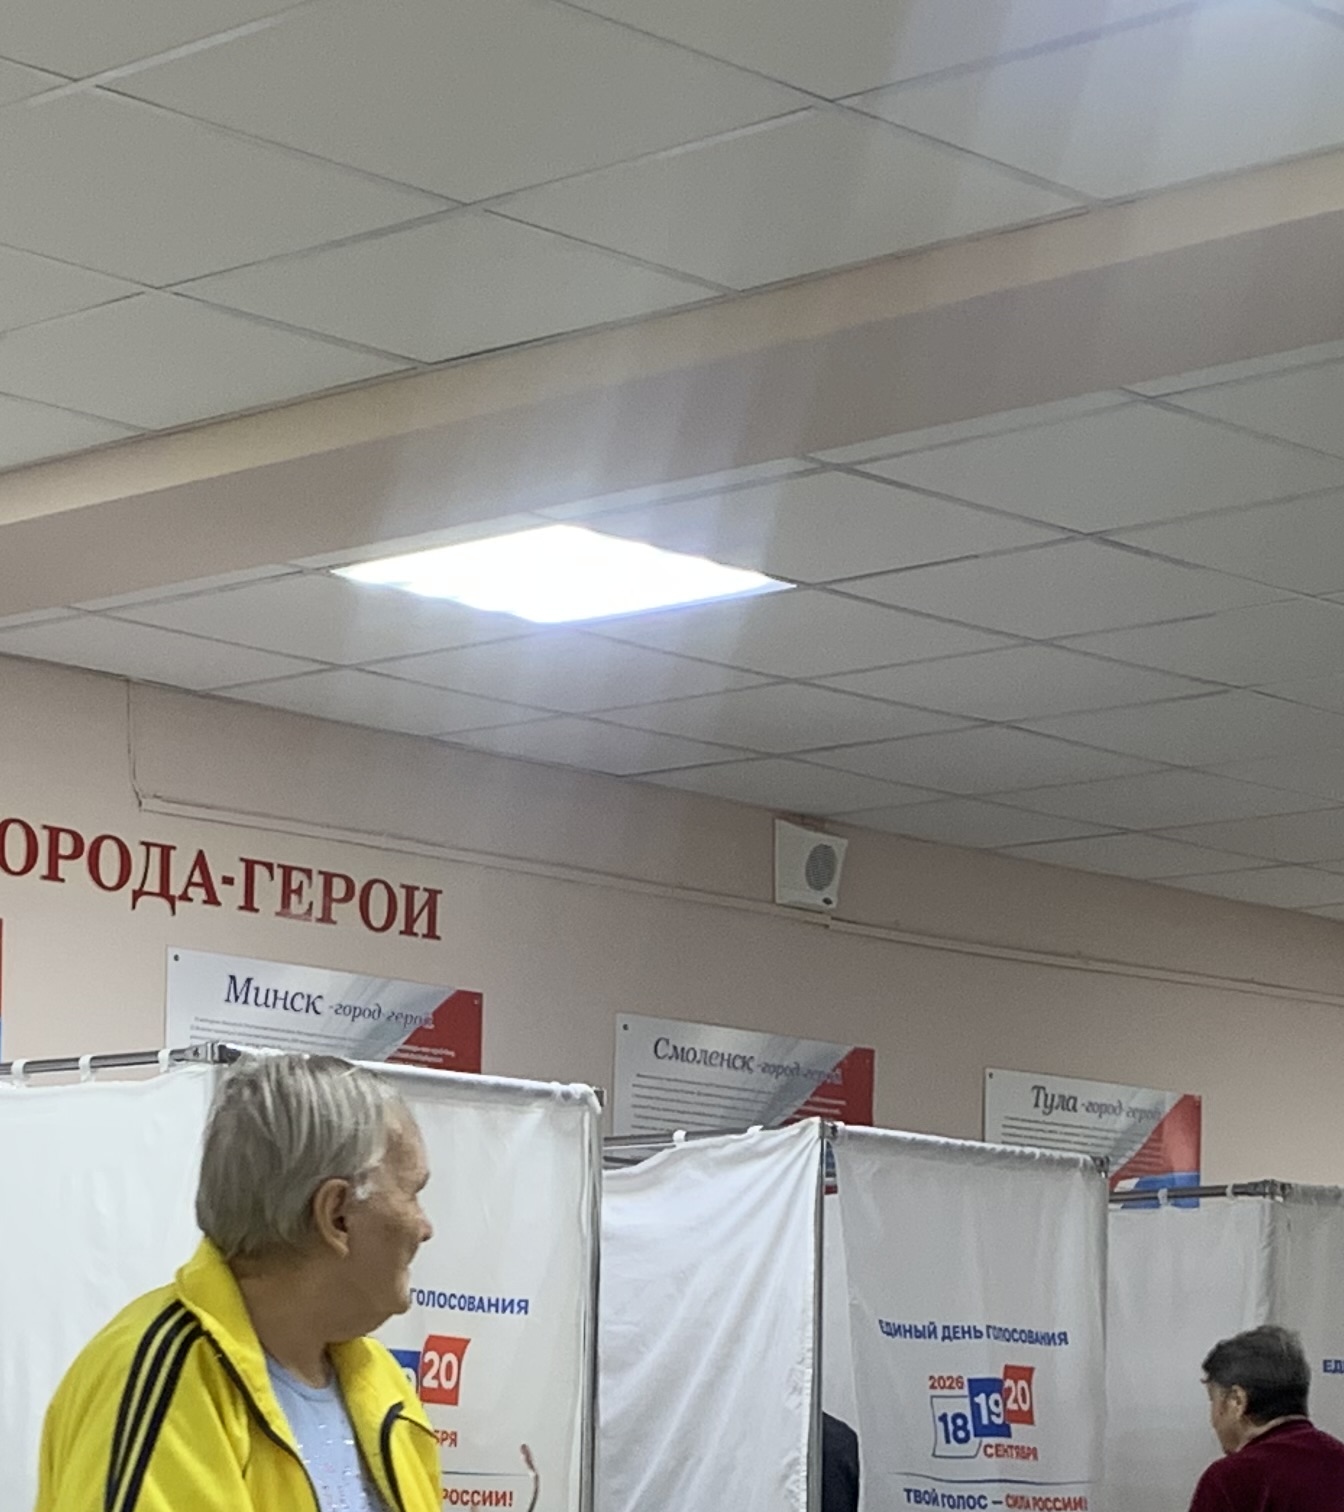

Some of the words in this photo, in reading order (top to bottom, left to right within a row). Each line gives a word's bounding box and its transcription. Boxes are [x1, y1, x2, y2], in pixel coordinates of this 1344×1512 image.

[224, 974, 324, 1016] Минск
[654, 1036, 755, 1073] Смоленск
[1032, 1085, 1078, 1116] Тула
[410, 1288, 530, 1316] ГОЛОСОВАНИЯ
[879, 1319, 938, 1340] ЕДИНЫЙ
[941, 1324, 984, 1342] ДЕНЬ
[986, 1324, 1069, 1346] ГОЛОСОВАНИЯ
[423, 1351, 458, 1389] 20
[928, 1375, 965, 1390] 2026
[938, 1412, 971, 1445] 18
[974, 1393, 1004, 1425] 19
[1004, 1379, 1031, 1412] 20
[903, 1488, 940, 1507] ТВОЙ
[941, 1493, 988, 1509] ГОЛОС
